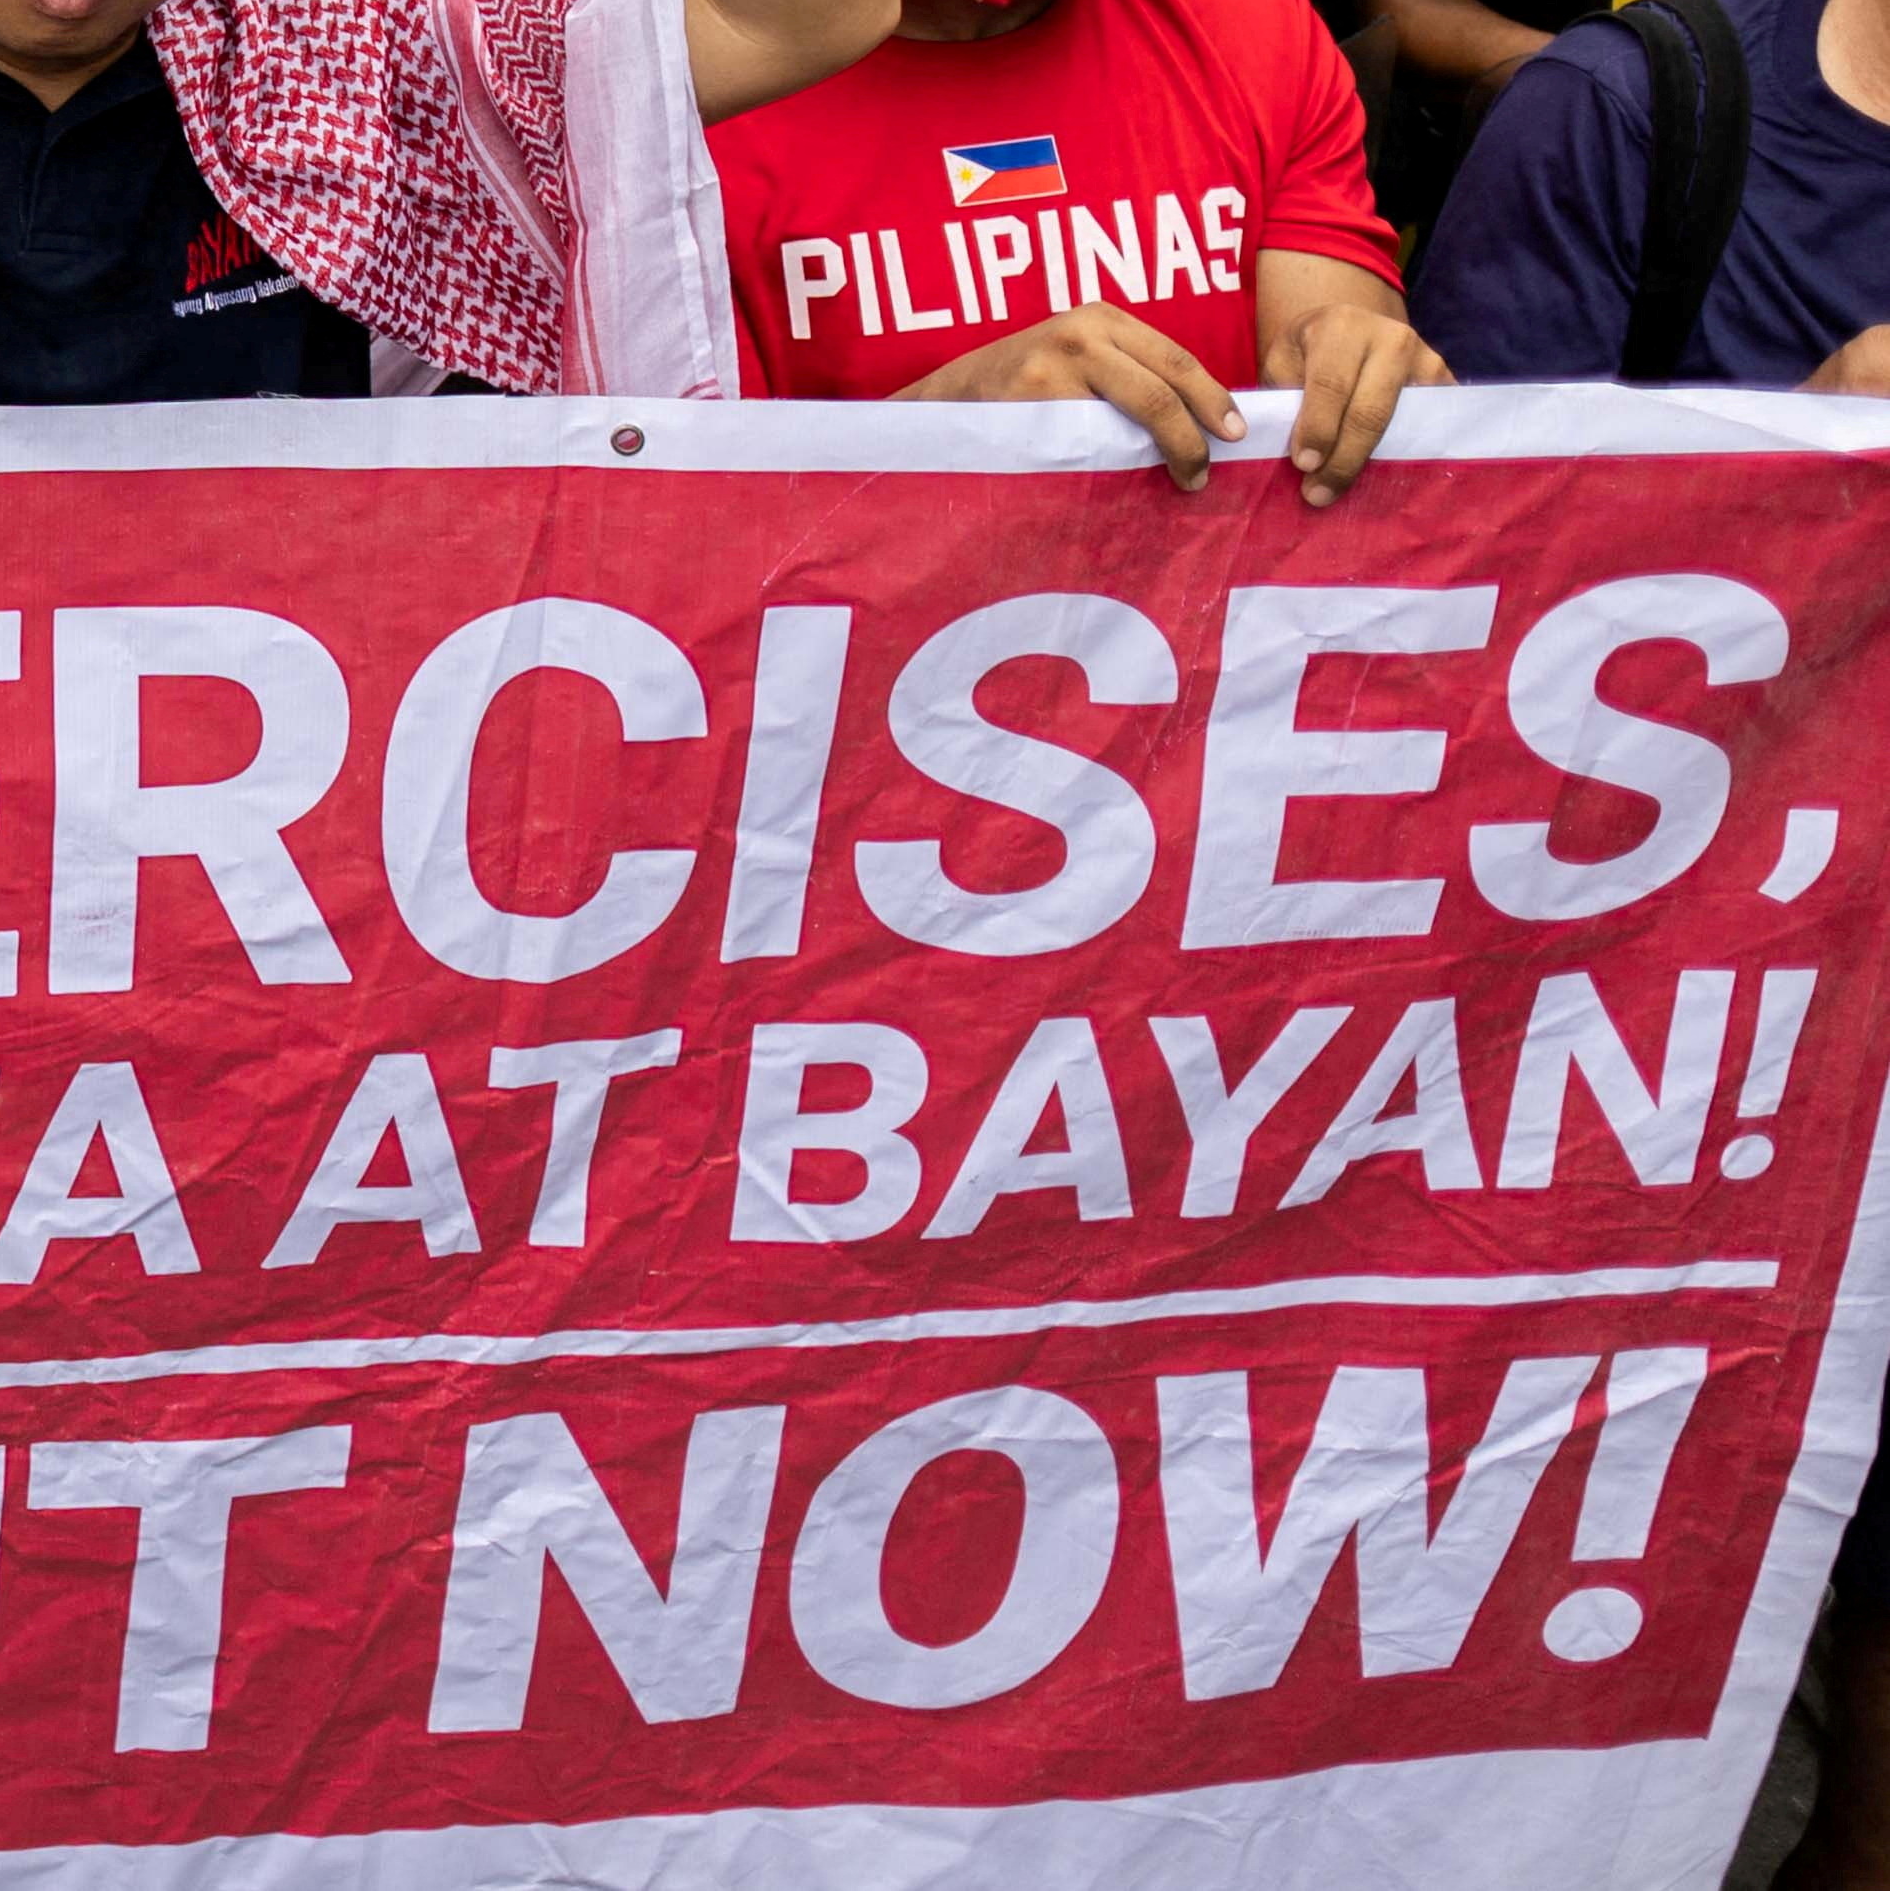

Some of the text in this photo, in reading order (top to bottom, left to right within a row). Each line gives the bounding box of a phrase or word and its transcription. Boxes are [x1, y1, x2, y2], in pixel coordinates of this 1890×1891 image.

[780, 186, 1247, 340] PILIPINAS
[261, 1028, 682, 1269] AT
[730, 969, 1818, 1243] BAYAN!
[428, 1346, 1707, 1733] NOW!
